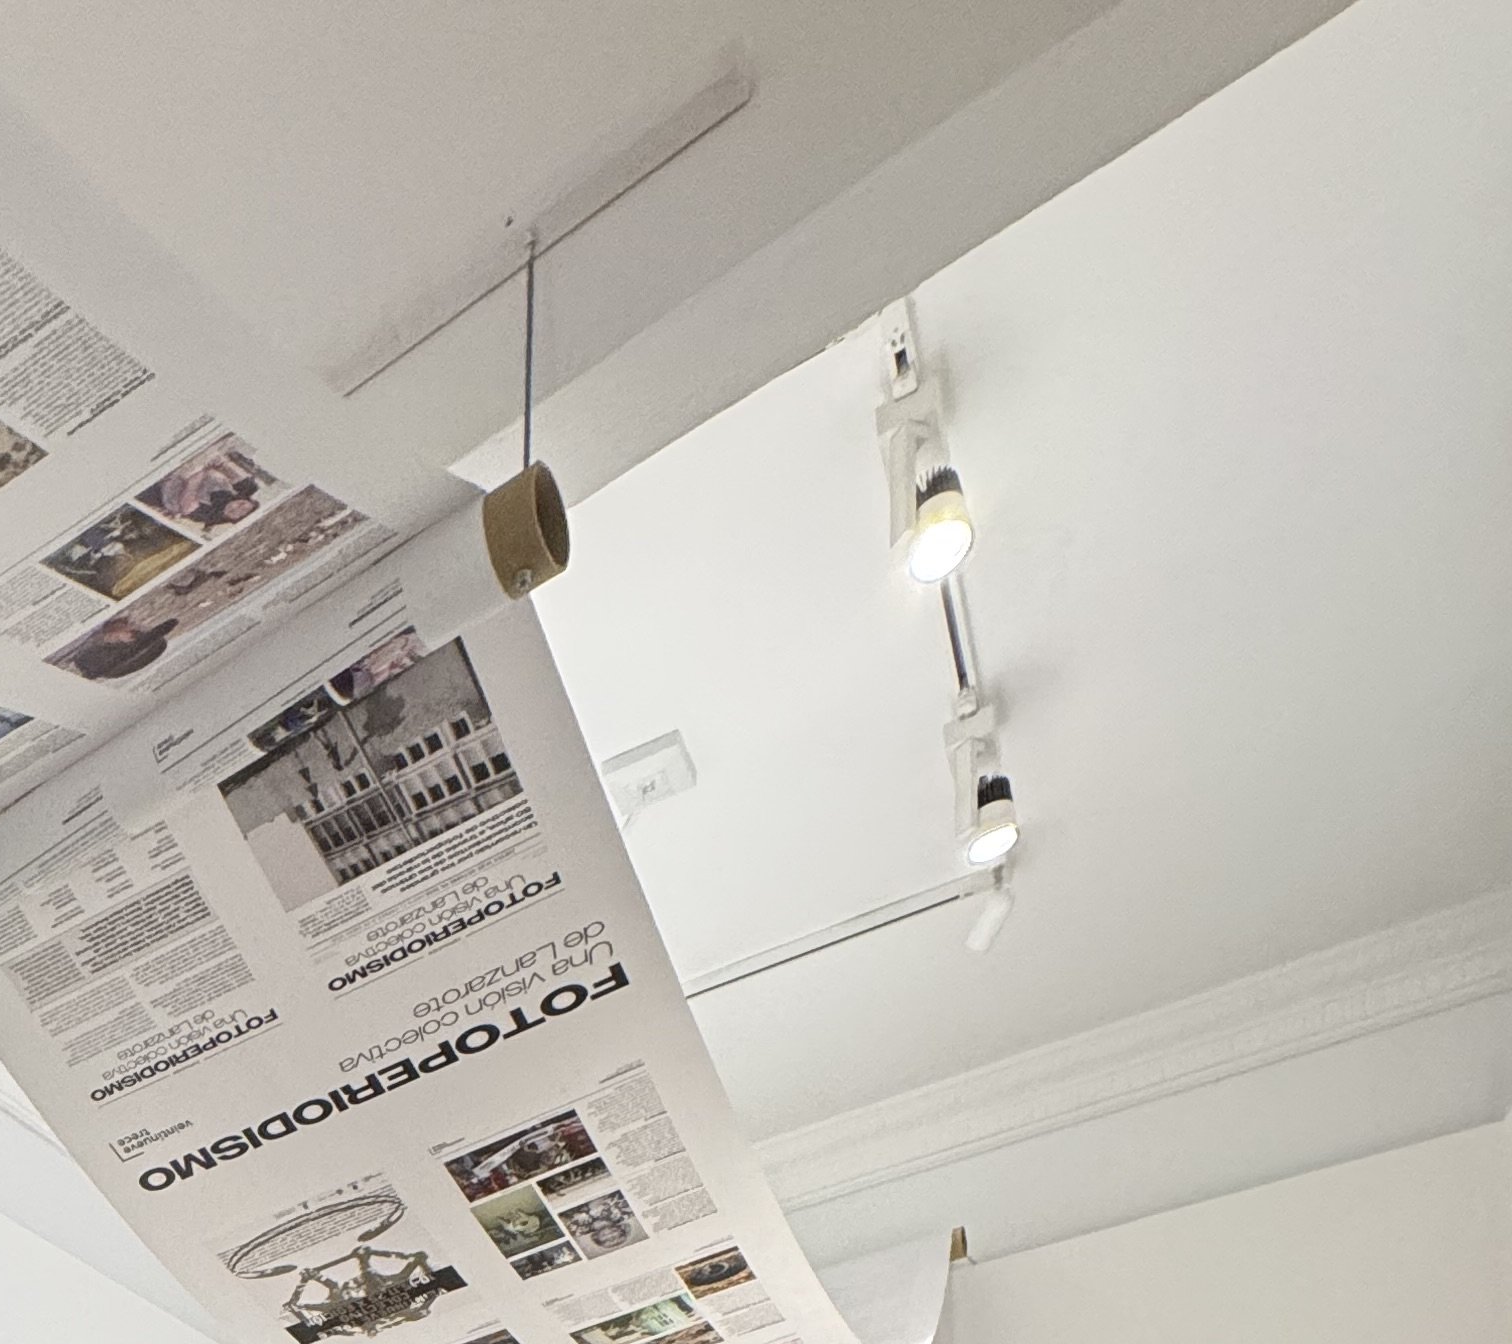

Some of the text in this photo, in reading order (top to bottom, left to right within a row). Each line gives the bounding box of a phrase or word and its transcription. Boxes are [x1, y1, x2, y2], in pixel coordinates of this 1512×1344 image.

[427, 893, 480, 929] visión
[460, 874, 490, 897] de
[483, 872, 525, 901] Una
[327, 870, 564, 992] FOTOPERIODISMO
[343, 919, 427, 969] colectiva
[364, 888, 460, 945] Lanzarote
[408, 918, 608, 1021] de Lanzarote
[335, 937, 615, 1076] Una visión colectiva
[90, 1006, 280, 1102] FOTOPERIODISMO
[101, 1007, 247, 1084] Una visión colectiva
[115, 1007, 216, 1064] de Lanzarote
[138, 959, 632, 1193] FOTOPERIODISMO
[116, 1127, 150, 1147] trece
[122, 1119, 193, 1155] veintinueve
